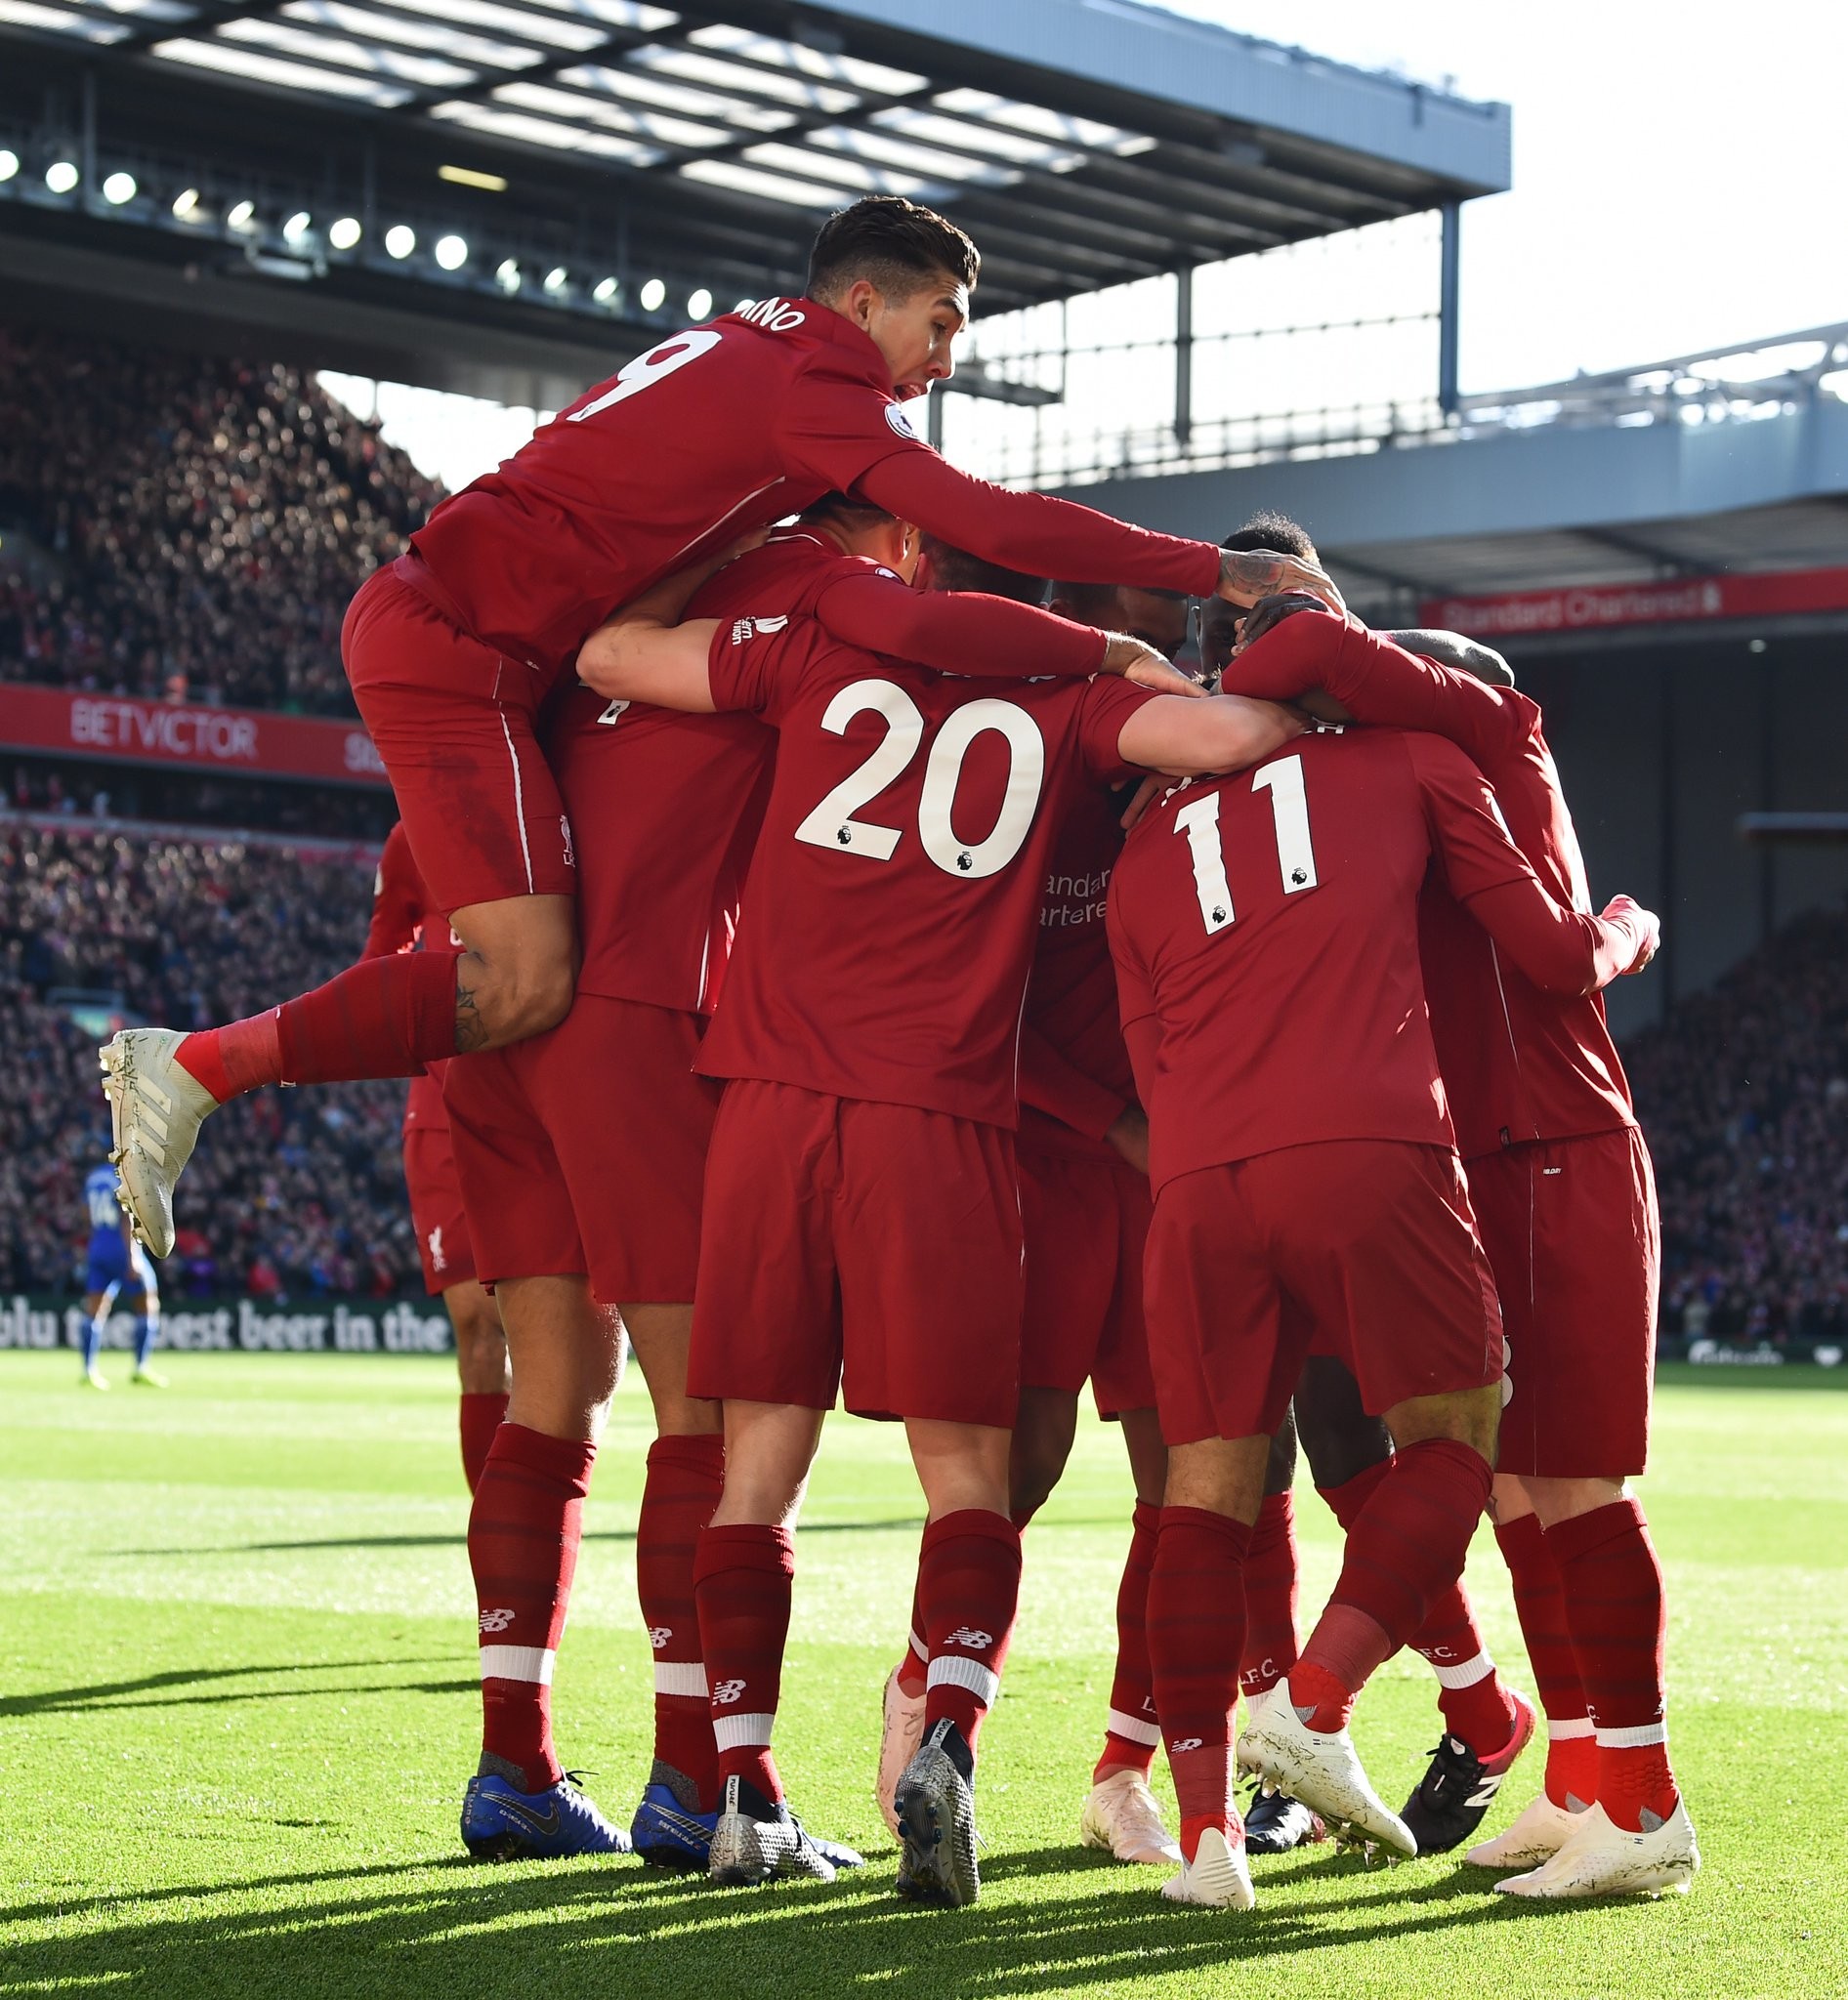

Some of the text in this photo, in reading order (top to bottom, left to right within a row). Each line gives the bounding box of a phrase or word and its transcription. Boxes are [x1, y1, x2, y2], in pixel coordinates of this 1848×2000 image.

[566, 330, 723, 422] 9
[70, 698, 259, 761] BETVICTOR
[794, 679, 1045, 879] 20
[1172, 753, 1319, 937] 11
[1038, 900, 1107, 927] artere
[1045, 869, 1111, 897] andar
[237, 1298, 329, 1351] beer
[333, 1303, 379, 1352] in
[382, 1301, 451, 1353] the
